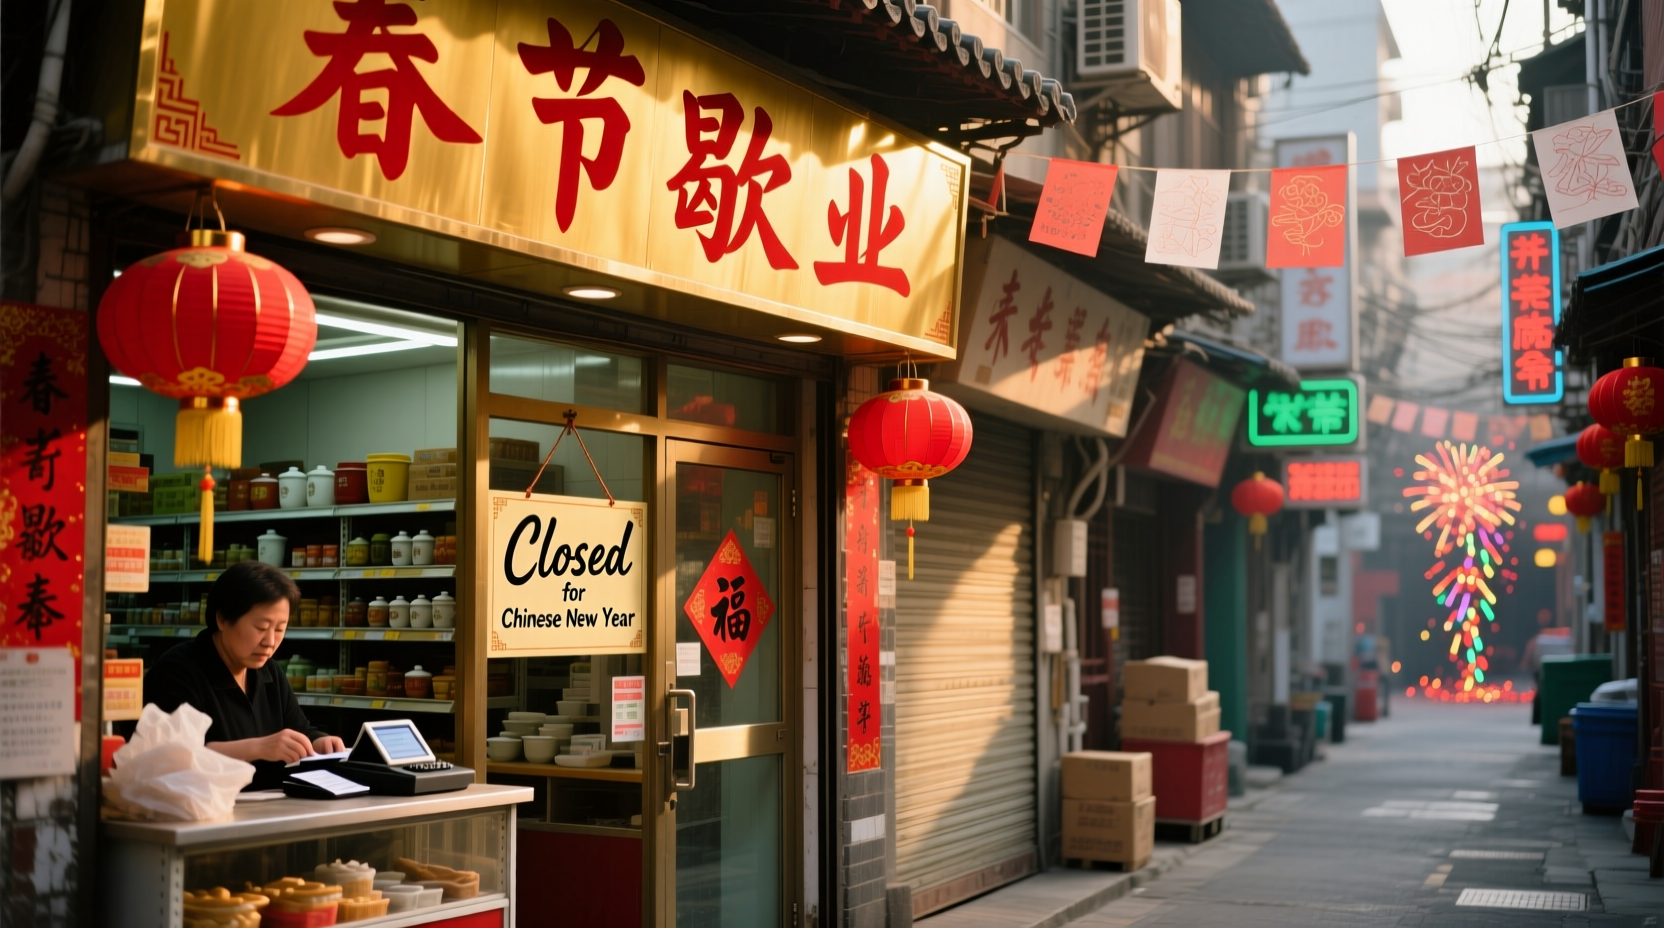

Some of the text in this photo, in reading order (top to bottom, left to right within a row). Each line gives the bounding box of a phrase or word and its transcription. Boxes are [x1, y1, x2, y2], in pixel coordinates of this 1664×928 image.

[269, 0, 911, 297] 春节歇业
[504, 514, 634, 586] Closed
[501, 606, 636, 629] Chinese New Year
[562, 582, 586, 602] for
[710, 575, 751, 643] 福
